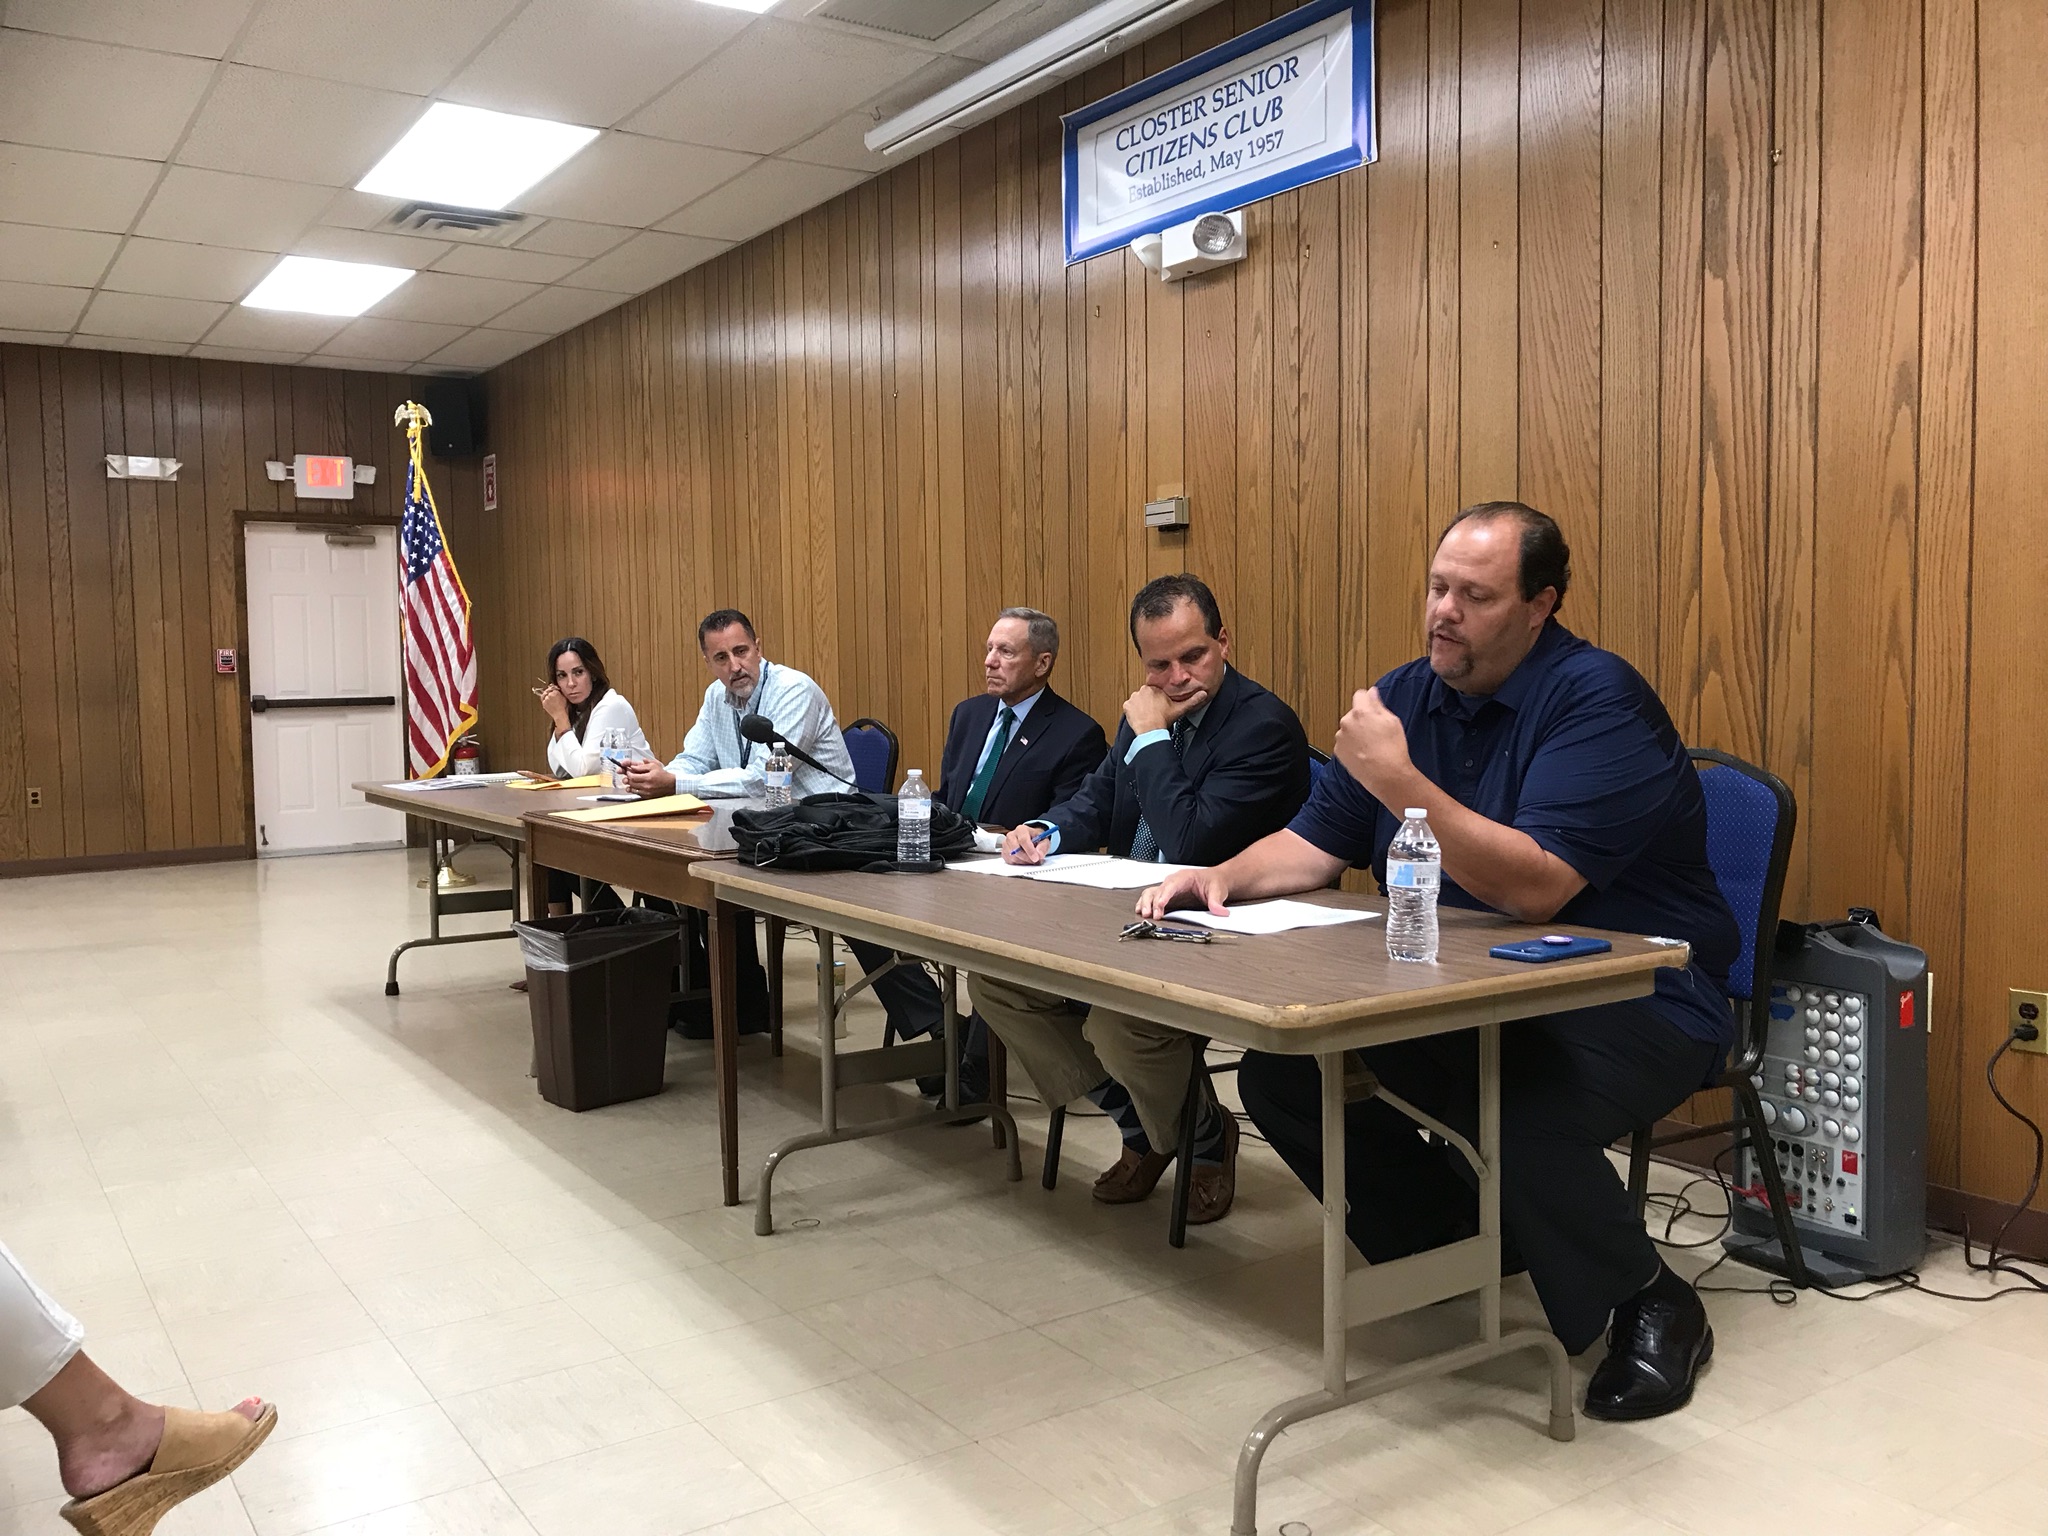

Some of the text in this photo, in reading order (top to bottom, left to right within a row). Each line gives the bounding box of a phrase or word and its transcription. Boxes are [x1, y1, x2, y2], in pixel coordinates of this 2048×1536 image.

[1116, 55, 1299, 151] CLOSTER SENIOR
[1125, 95, 1283, 177] CITIZENS CLUB
[1128, 129, 1284, 204] Established, May 1957
[306, 457, 344, 487] EXIT
